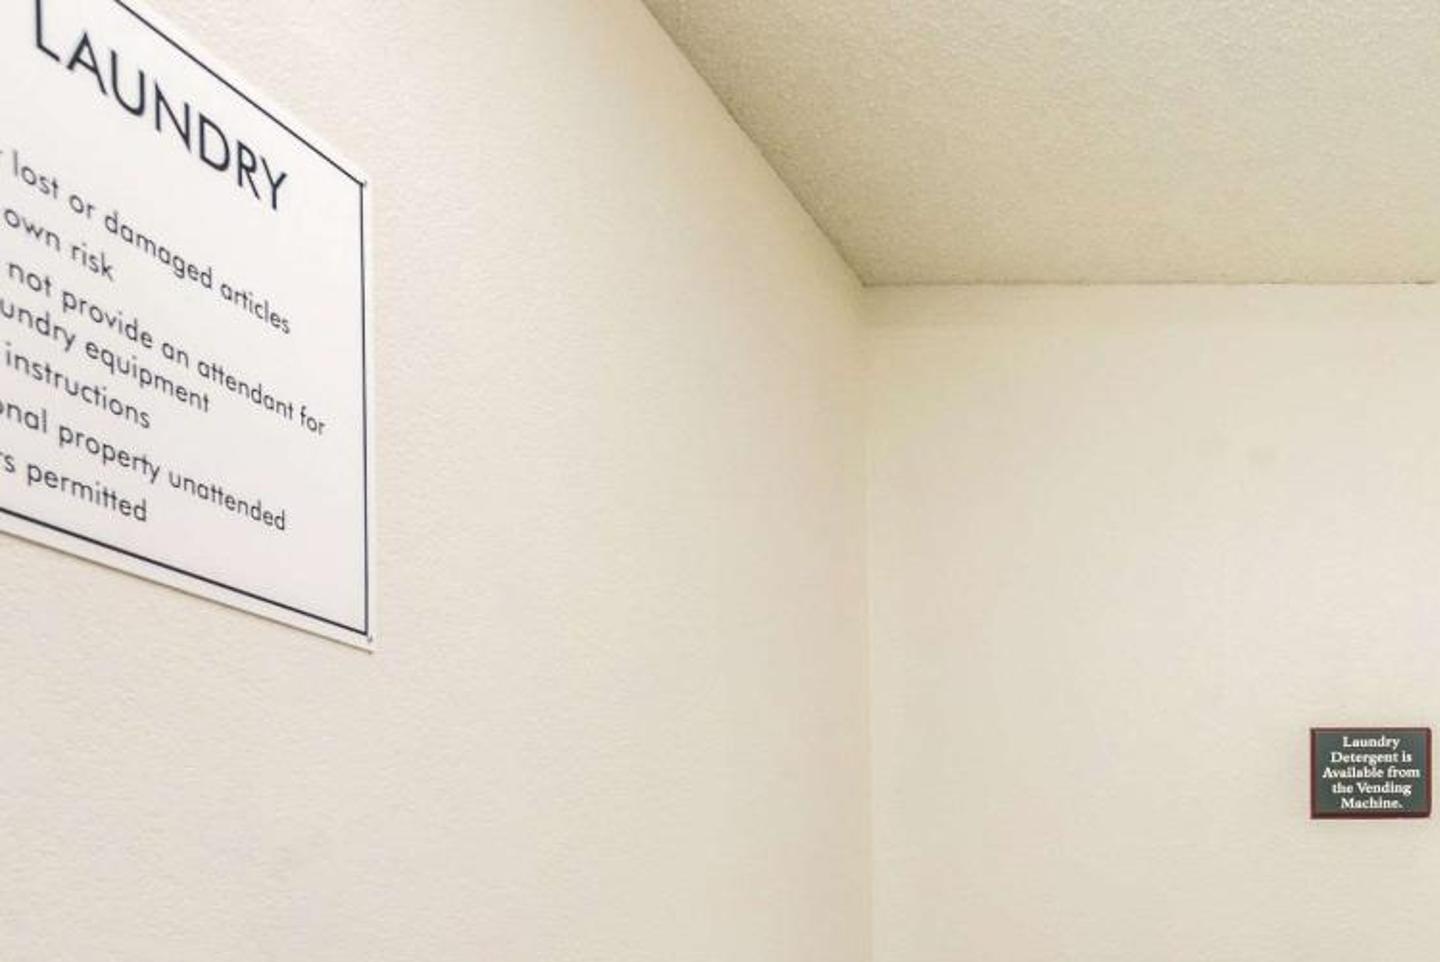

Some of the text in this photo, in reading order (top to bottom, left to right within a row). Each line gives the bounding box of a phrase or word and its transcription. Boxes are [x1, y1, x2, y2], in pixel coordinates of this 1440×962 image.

[34, 0, 287, 211] LAUNDRY
[3, 207, 115, 283] own risk
[12, 148, 291, 335] lost or damaged articles
[5, 340, 151, 430] instructions
[8, 261, 326, 436] not provide an attendant for
[85, 340, 210, 413] equipment
[26, 462, 148, 523] permitted
[58, 423, 161, 484] property
[168, 470, 286, 531] unattended
[1322, 765, 1421, 778] Available from
[1330, 750, 1412, 766] Detergent is
[1342, 735, 1400, 750] Laundry
[1331, 780, 1413, 797] the Vending
[1340, 796, 1403, 809] Machine.
